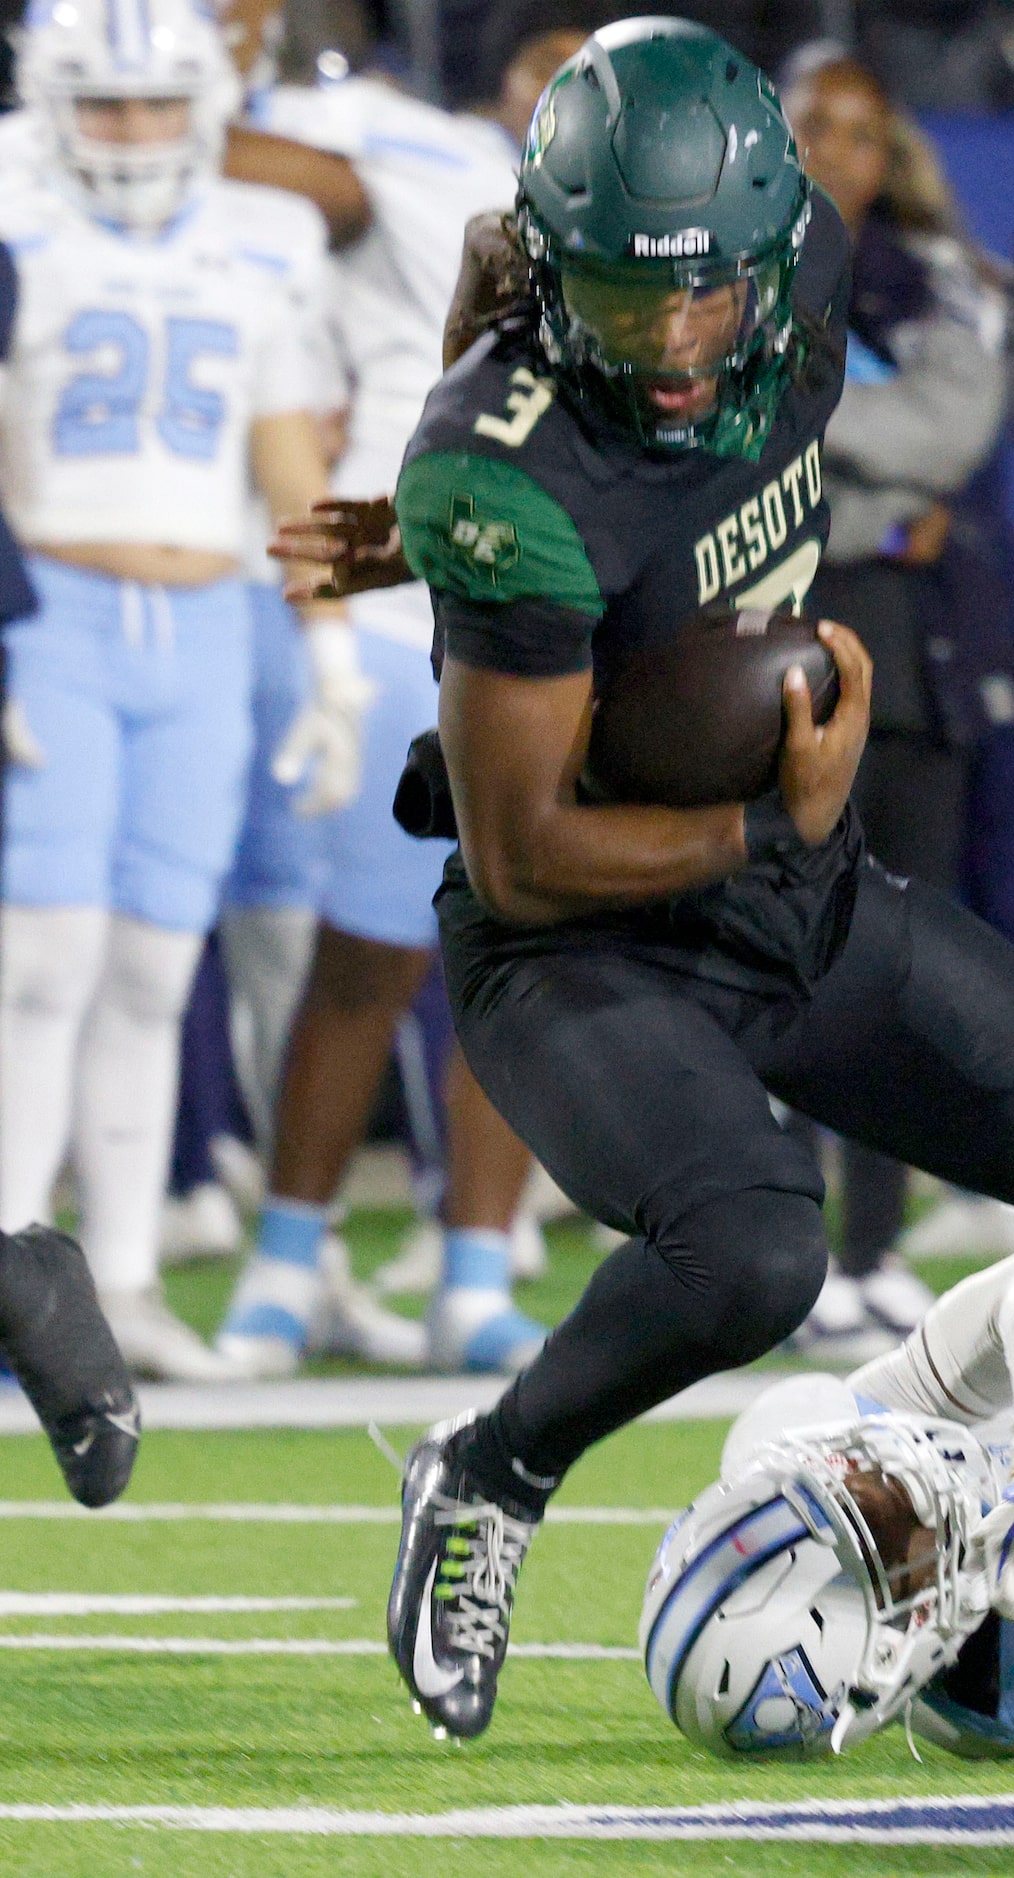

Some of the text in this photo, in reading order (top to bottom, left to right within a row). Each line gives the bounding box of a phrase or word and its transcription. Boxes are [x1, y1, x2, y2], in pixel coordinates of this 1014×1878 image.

[52, 308, 241, 464] 25
[474, 366, 553, 448] 3
[695, 438, 823, 607] DESOTO
